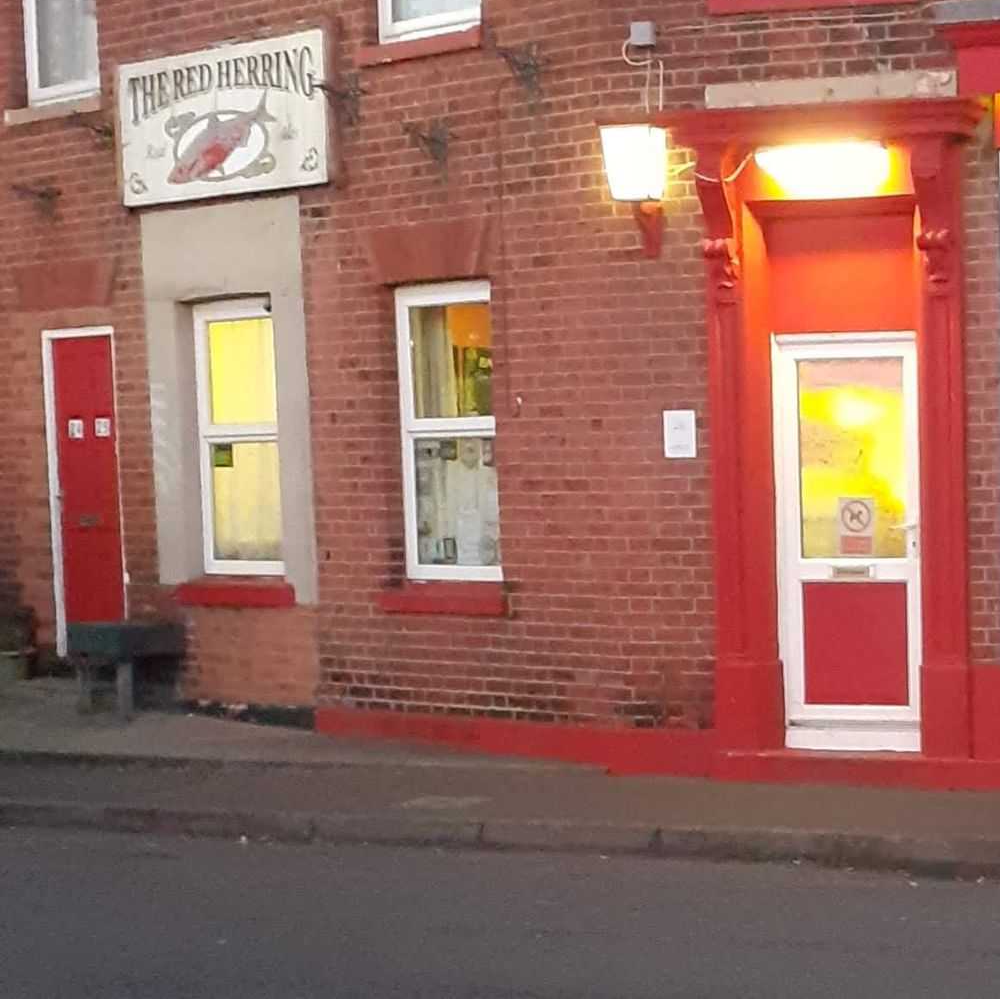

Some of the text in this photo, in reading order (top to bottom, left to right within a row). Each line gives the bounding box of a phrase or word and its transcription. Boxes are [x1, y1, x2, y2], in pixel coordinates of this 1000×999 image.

[128, 45, 316, 126] THE RED HERRING
